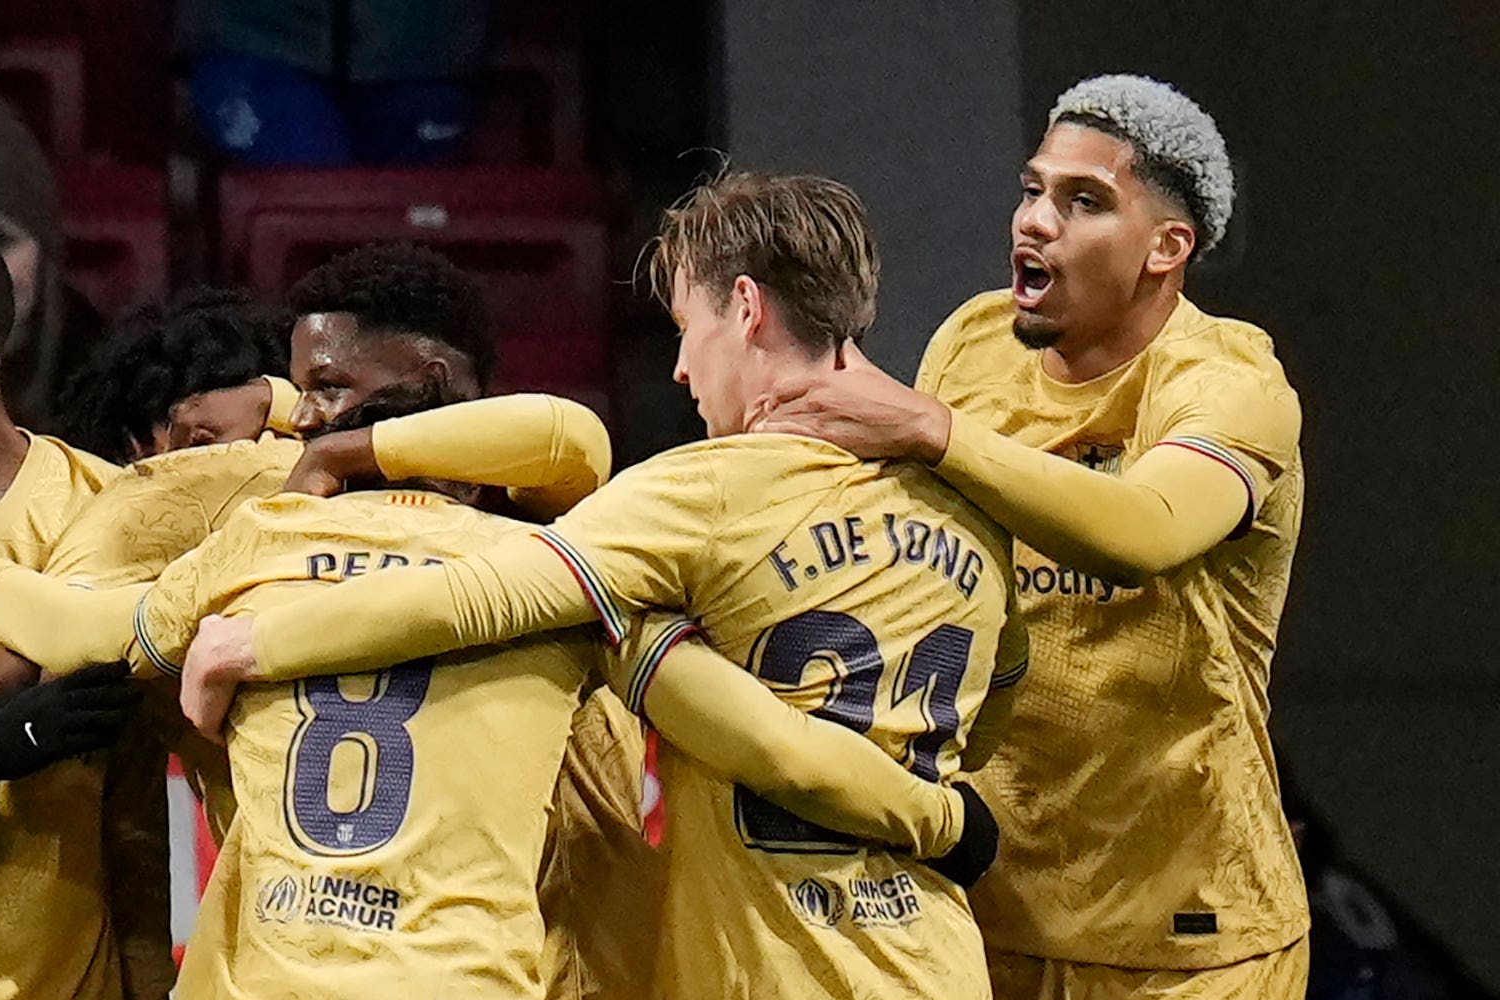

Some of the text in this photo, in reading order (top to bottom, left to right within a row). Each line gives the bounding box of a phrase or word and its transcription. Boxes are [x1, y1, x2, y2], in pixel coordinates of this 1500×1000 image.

[882, 513, 984, 601] JONG
[282, 657, 436, 858] 8
[308, 874, 401, 909] UNHCR
[848, 873, 913, 901] UNHCR
[304, 897, 396, 931] ACNUR
[851, 894, 920, 920] ACNUR
